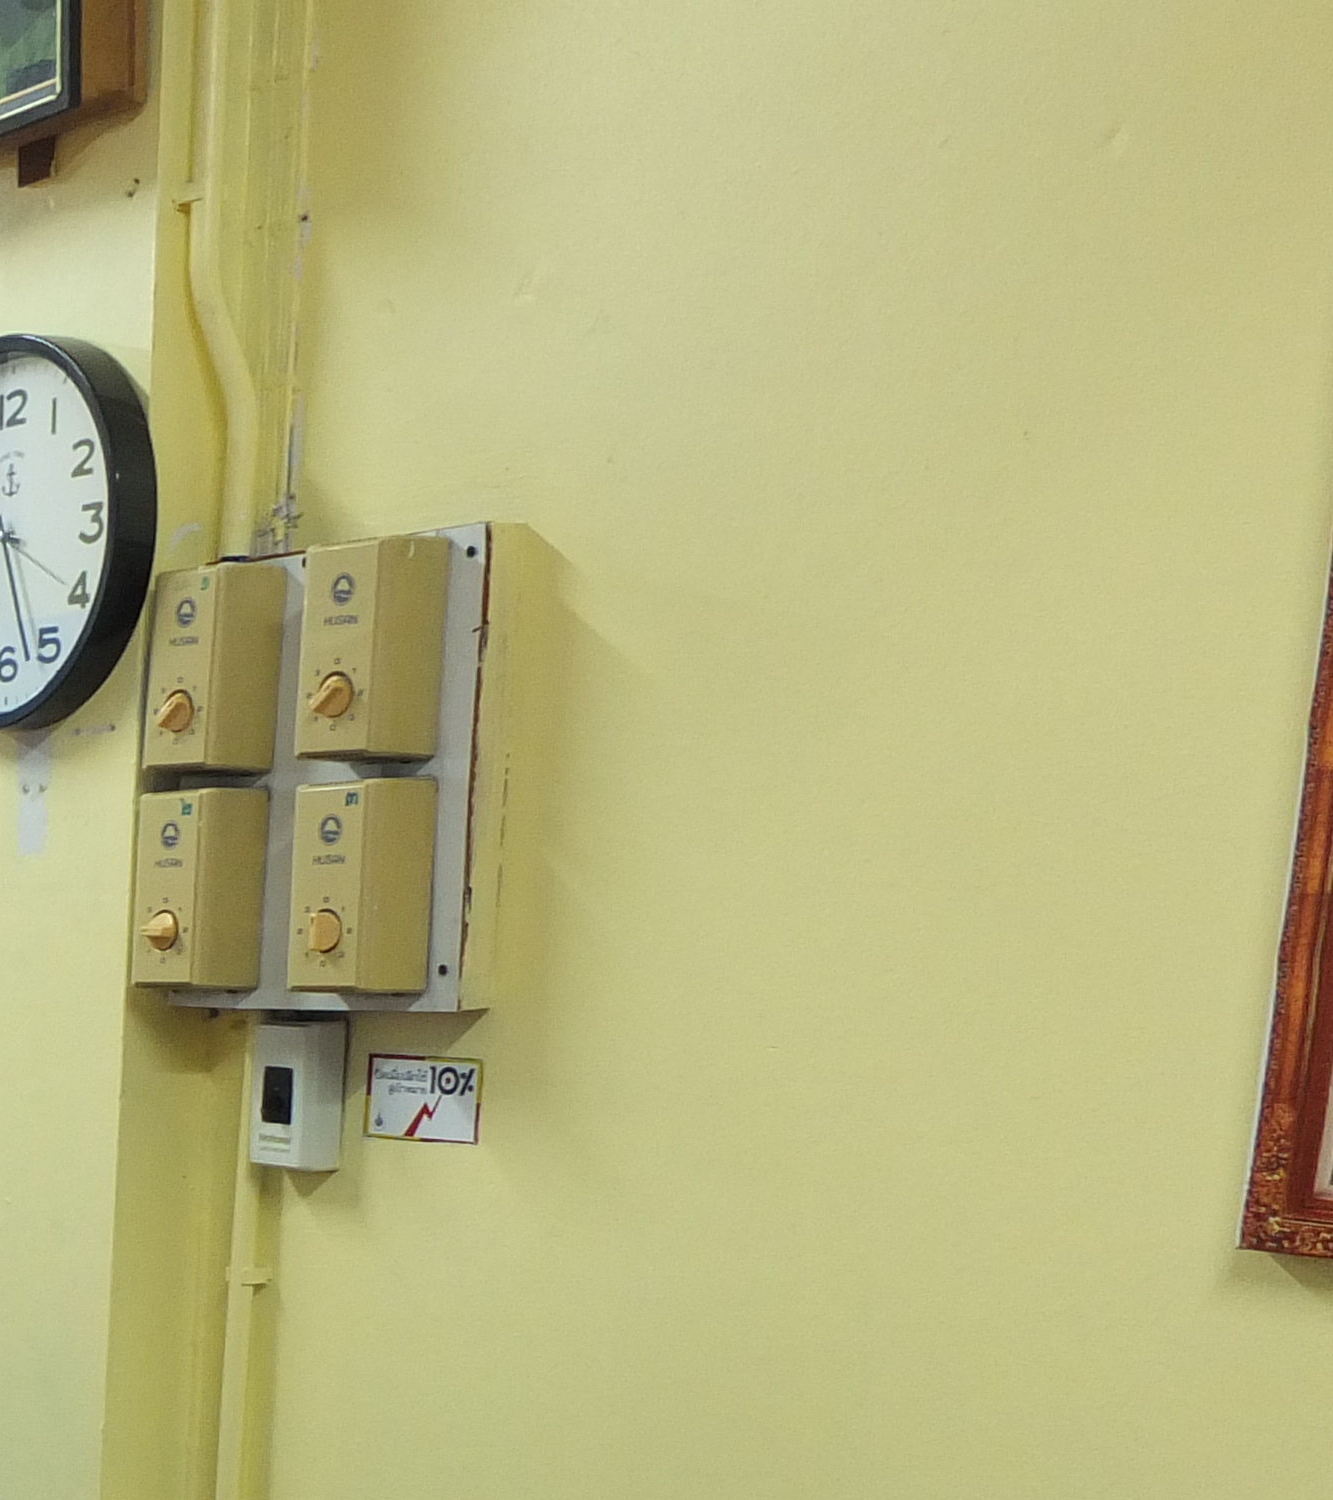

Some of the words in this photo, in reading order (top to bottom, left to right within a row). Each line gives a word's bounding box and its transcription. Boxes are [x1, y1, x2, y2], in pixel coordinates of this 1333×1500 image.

[0, 389, 27, 430] 12
[50, 397, 57, 435] 1
[71, 438, 95, 478] 2
[78, 501, 104, 544] 3
[67, 570, 91, 609] 4
[35, 626, 61, 664] 5
[429, 1065, 476, 1097] 10%
